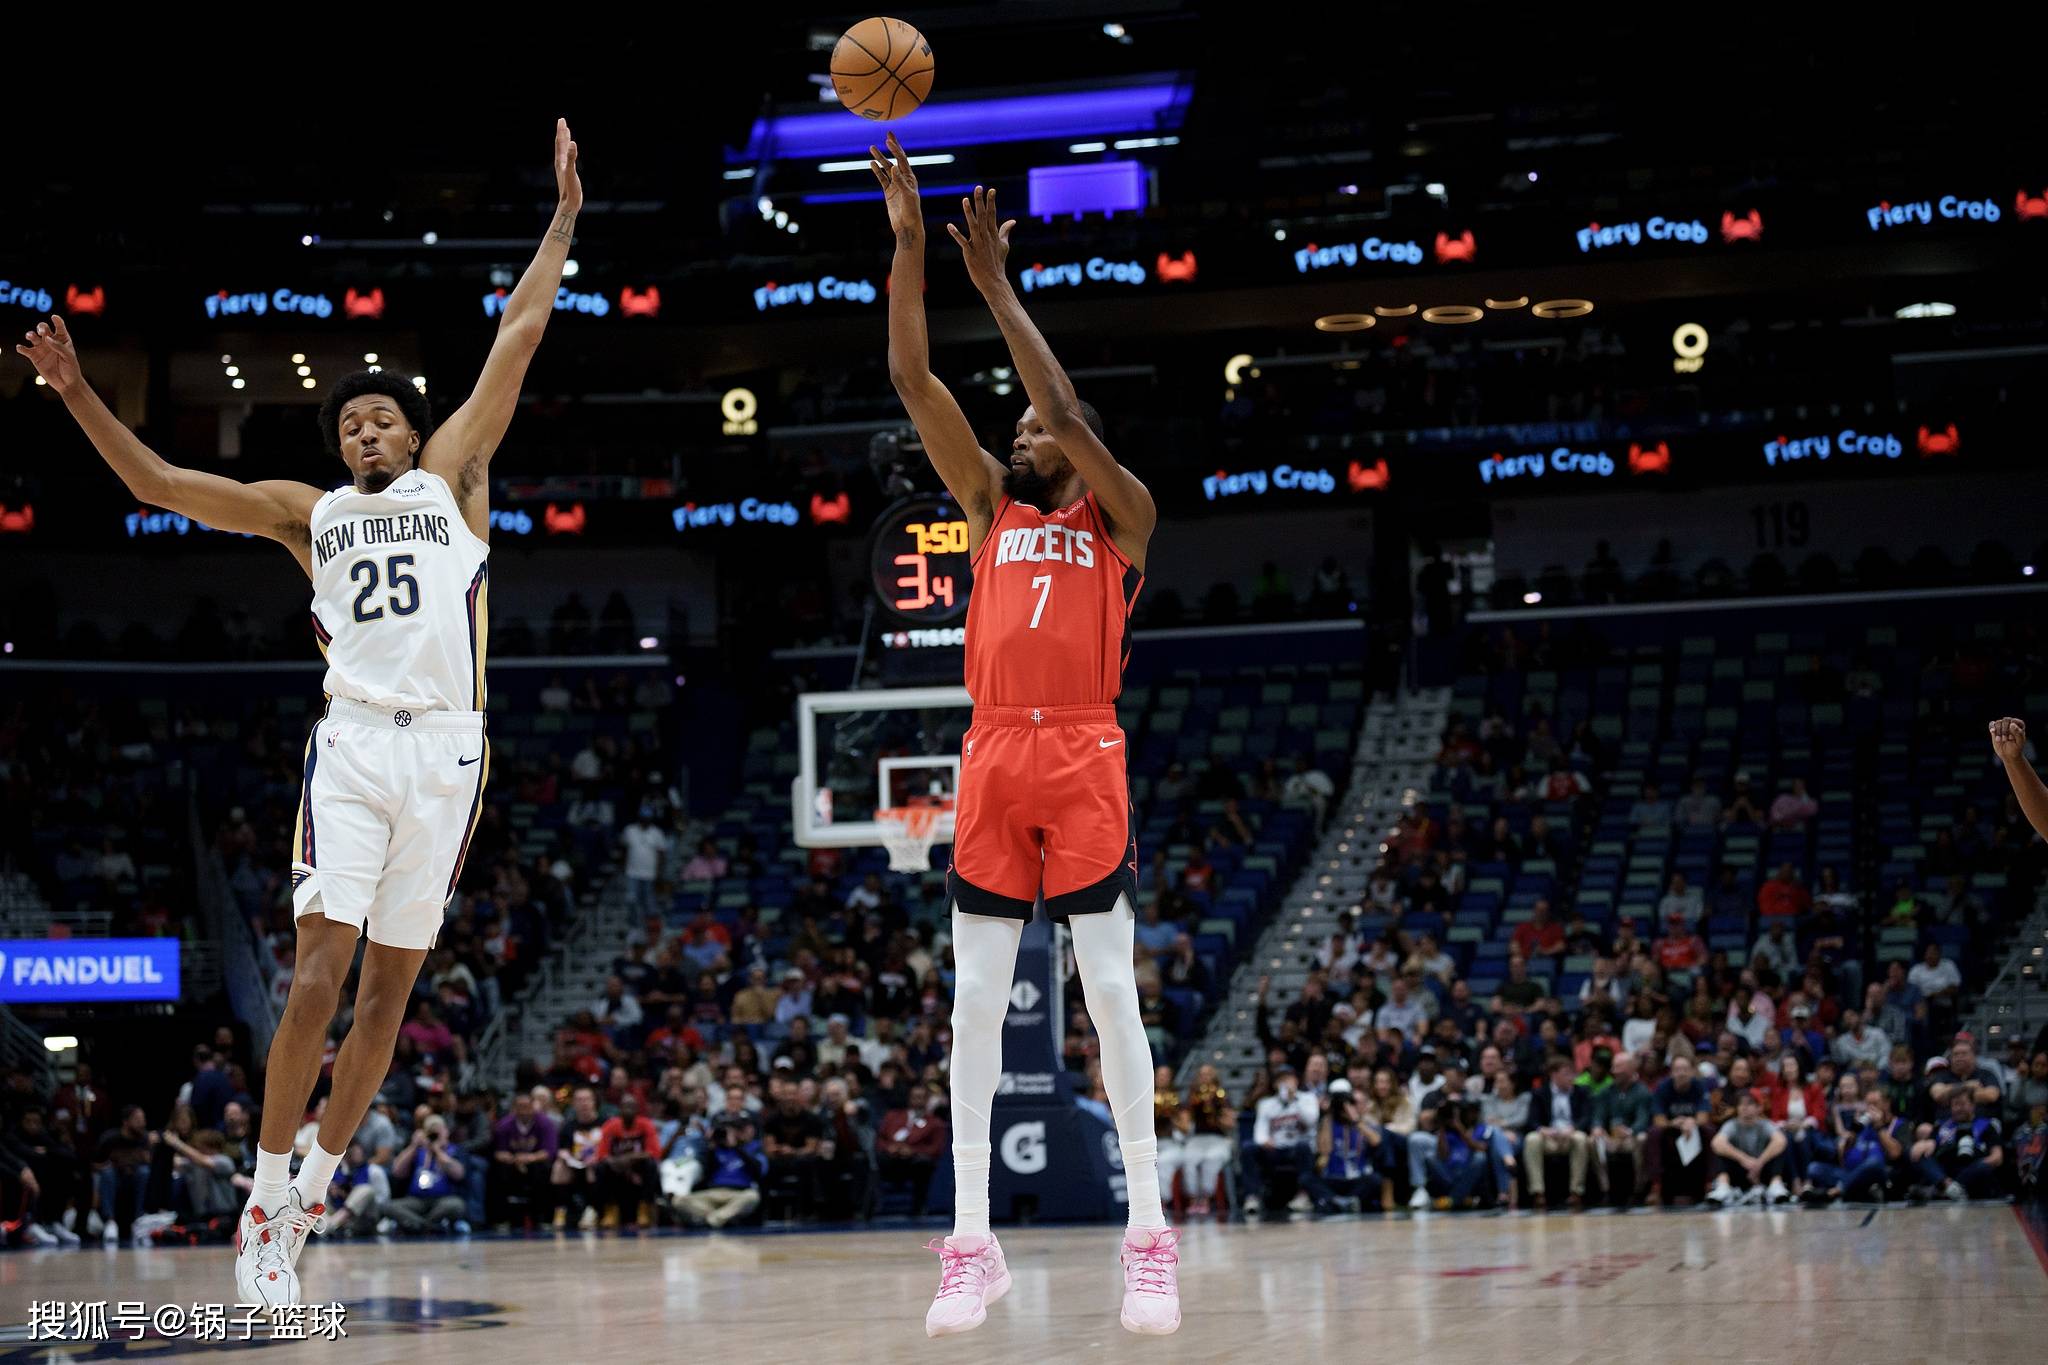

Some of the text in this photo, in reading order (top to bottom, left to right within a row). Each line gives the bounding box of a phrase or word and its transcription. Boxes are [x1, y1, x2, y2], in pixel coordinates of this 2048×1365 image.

[1866, 194, 2001, 231] Fiery Crab
[1576, 216, 1709, 253] Fiery Crab
[1294, 236, 1424, 274] Fiery Crab
[1020, 256, 1146, 293] Fiery Crab
[0, 279, 53, 313] Crab
[204, 288, 333, 320] Fiery Crab
[552, 286, 610, 317] Crab
[753, 275, 877, 312] Fiery Crab
[1478, 446, 1615, 484] Fiery Crab
[1763, 429, 1903, 466] Fiery Crab
[1202, 464, 1336, 501] Fiery Crab
[125, 507, 190, 538] Fiery
[489, 509, 533, 536] rab
[672, 496, 800, 532] Fiery Crab
[1752, 502, 1808, 546] 119
[314, 513, 450, 568] NEW ORLEANS
[994, 523, 1095, 569] ROCETS
[349, 553, 421, 624] 25
[894, 554, 954, 610] 3.4
[1029, 575, 1052, 629] 7
[13, 955, 163, 986] FANDUEL
[1000, 1121, 1047, 1174] G
